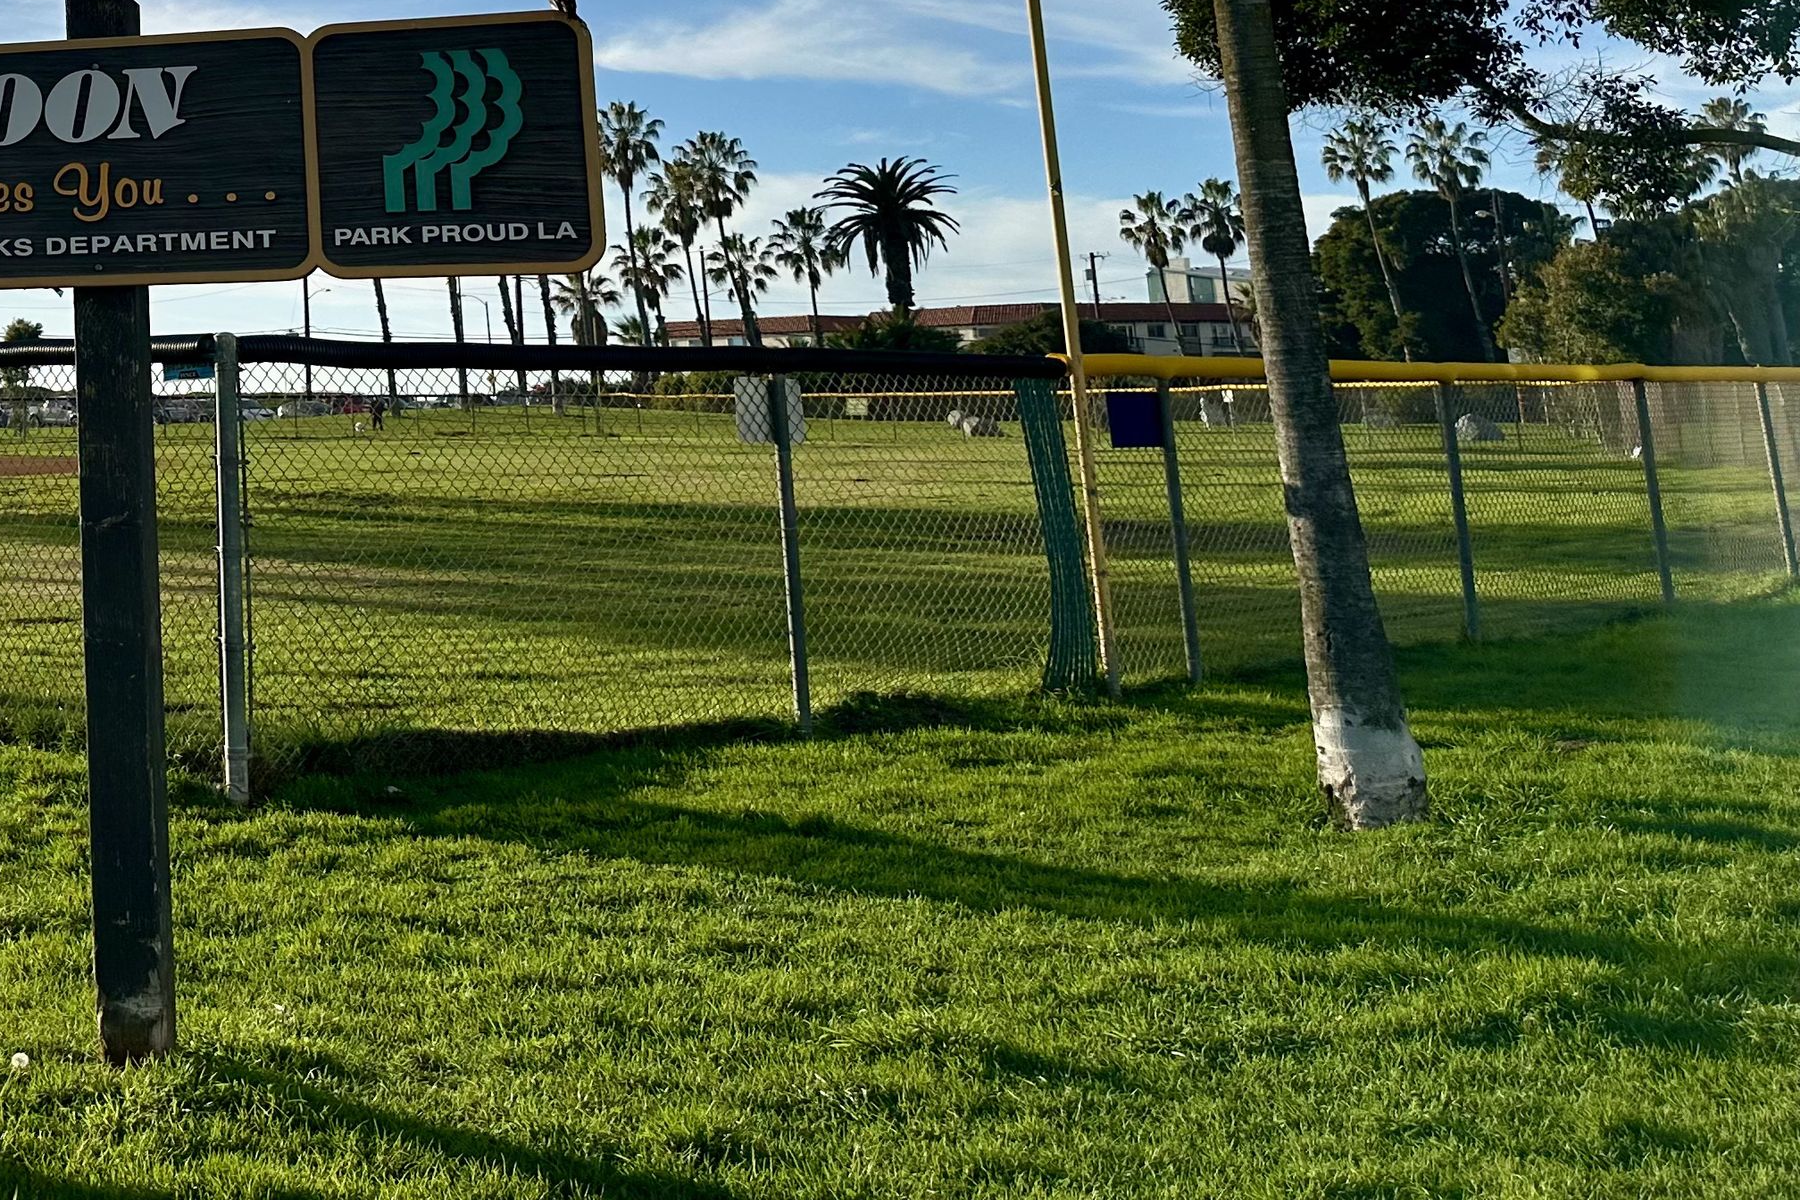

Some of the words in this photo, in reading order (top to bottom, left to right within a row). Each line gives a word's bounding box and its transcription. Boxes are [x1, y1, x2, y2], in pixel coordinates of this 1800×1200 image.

[53, 162, 164, 222] You
[46, 229, 277, 256] DEPARTMENT
[333, 226, 413, 247] PARK
[421, 222, 529, 244] PROUD
[536, 220, 578, 240] LA
